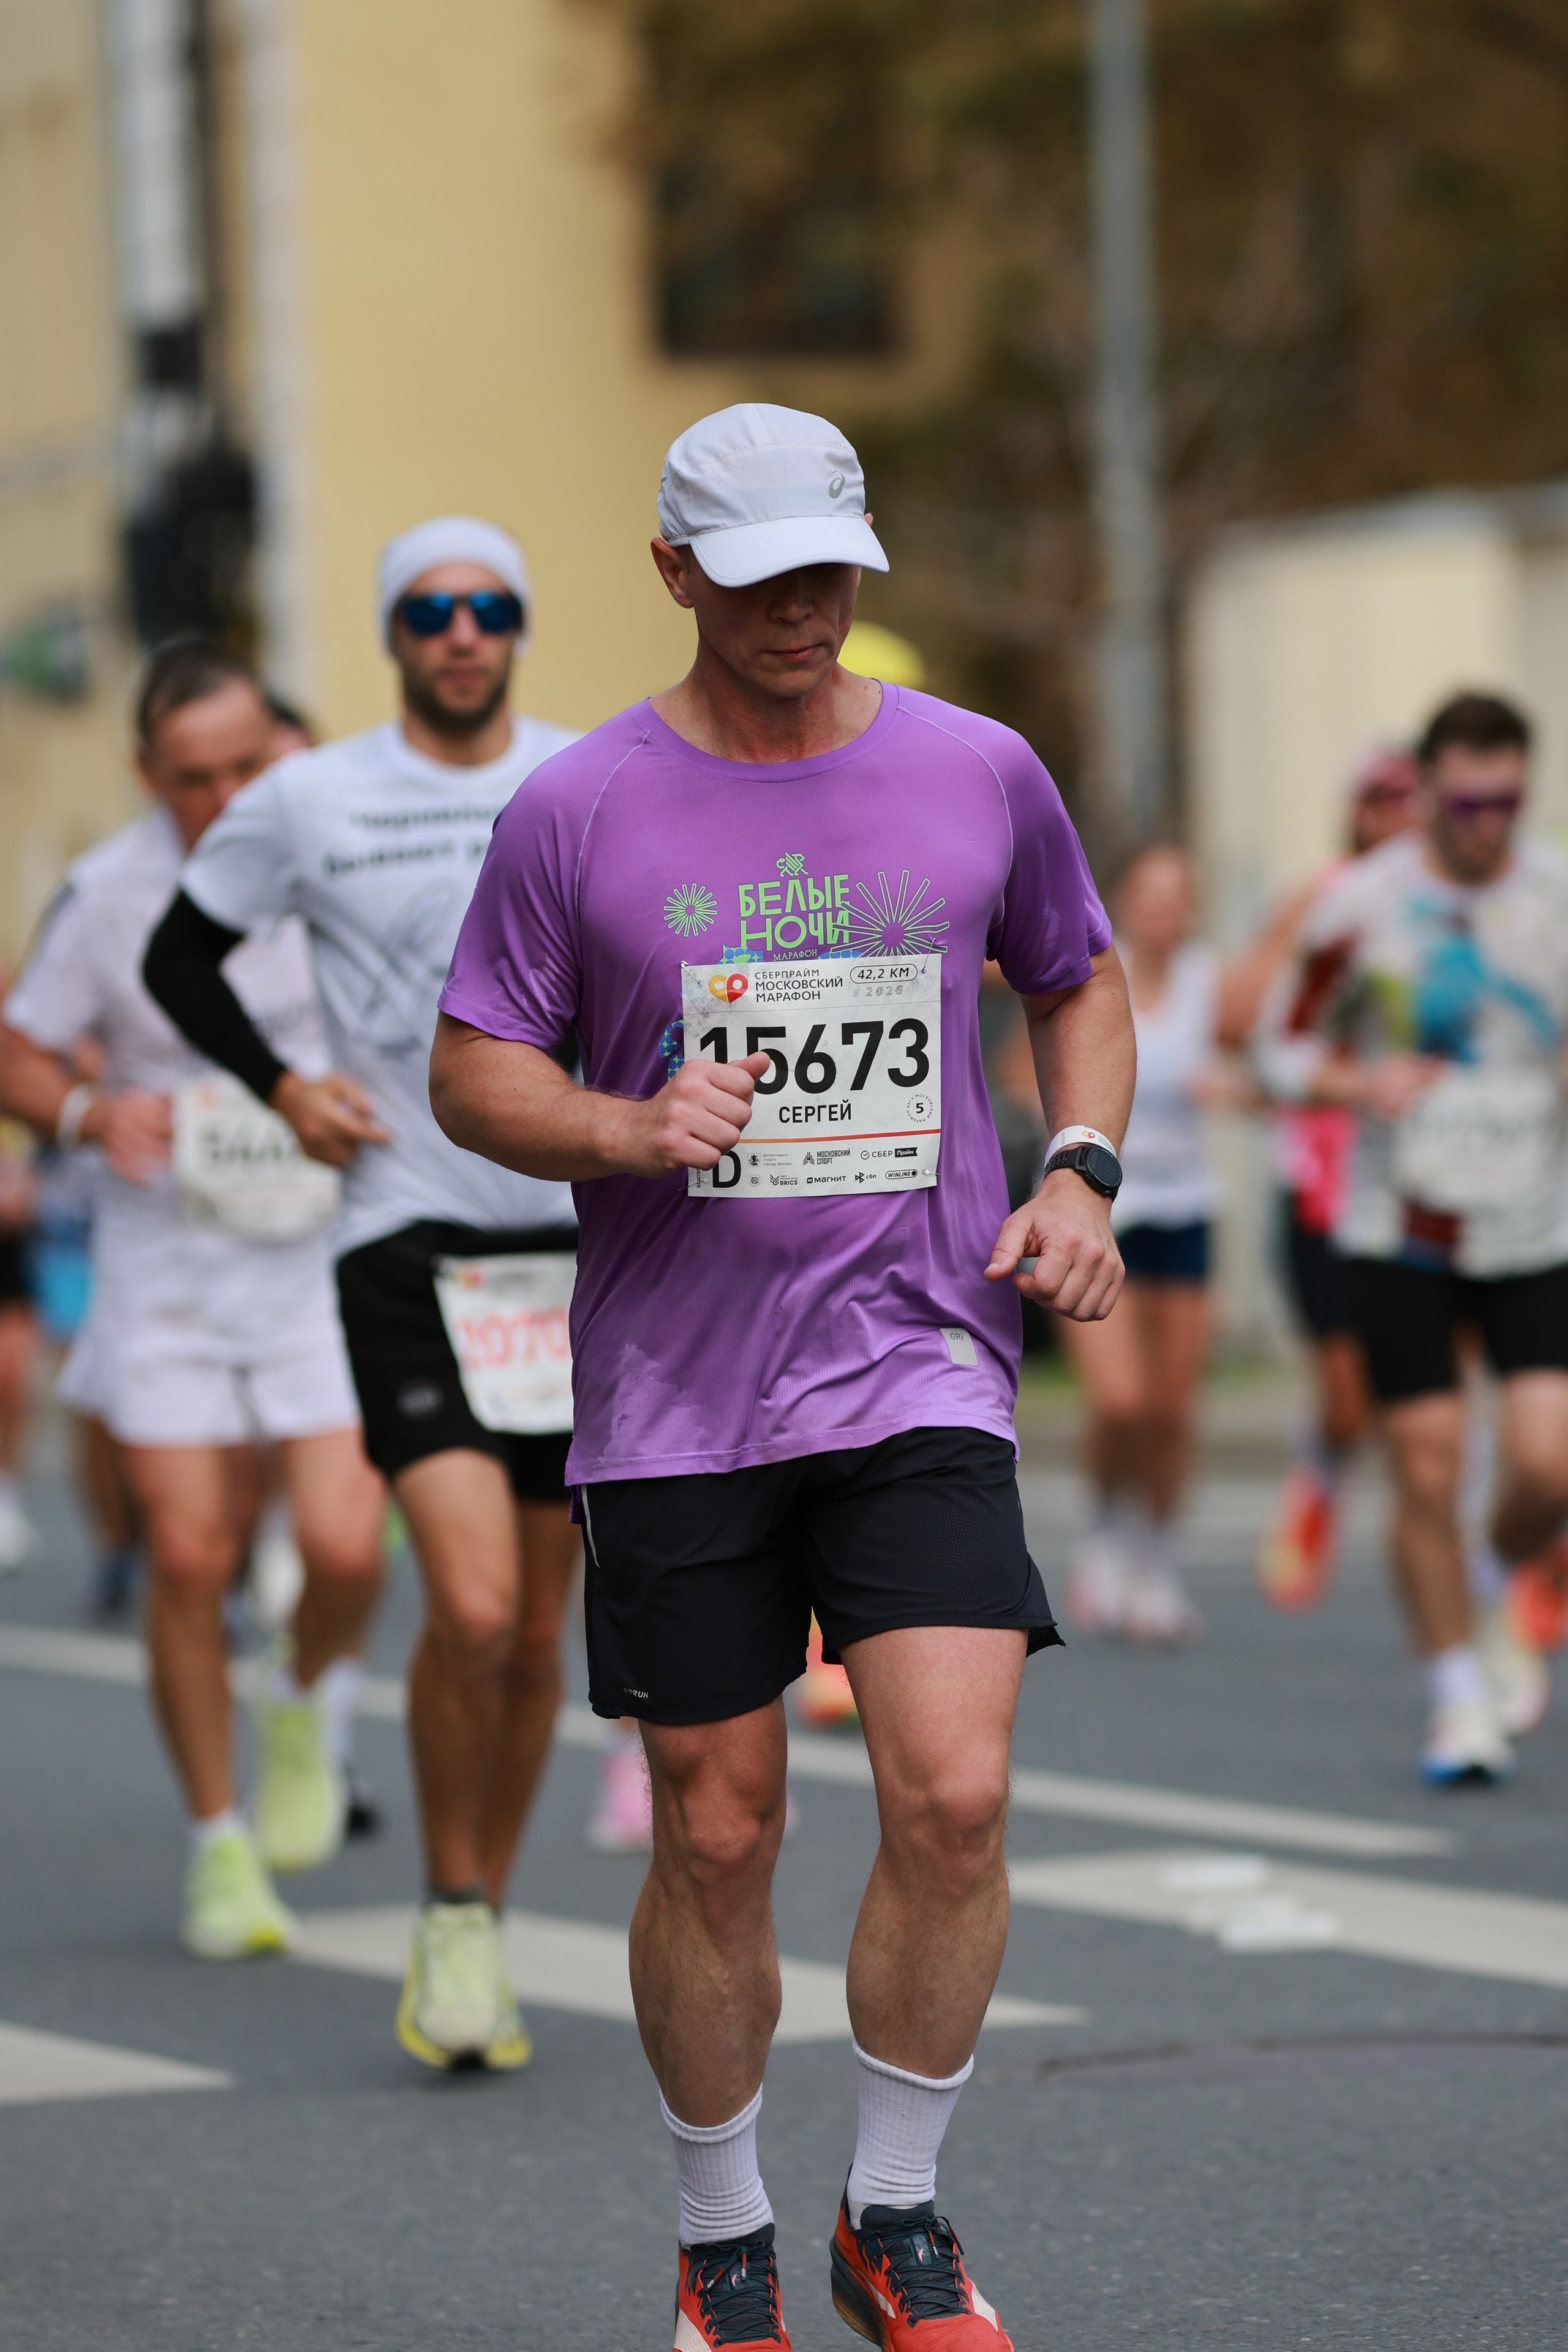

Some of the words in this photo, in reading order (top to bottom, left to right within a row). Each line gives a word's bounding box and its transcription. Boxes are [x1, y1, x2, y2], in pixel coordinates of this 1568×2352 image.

[738, 874, 850, 918] БЕЛЫЕ
[740, 910, 850, 951] НОЧИ
[773, 949, 818, 962] МАРАФОН
[755, 968, 820, 980] СБЕРПРАЙМ
[858, 968, 884, 980] 42,2
[890, 967, 910, 978] КМ
[756, 976, 843, 992] МОСКОВСКИЙ
[756, 990, 821, 1003] МАРАФОН
[865, 985, 903, 997] 2026
[699, 1017, 930, 1095] 15673
[778, 1099, 852, 1124] СЕРГЕЙ
[916, 1102, 924, 1114] 5
[816, 1148, 851, 1158] МОСКОВСКИЙ
[712, 1150, 741, 1188] D
